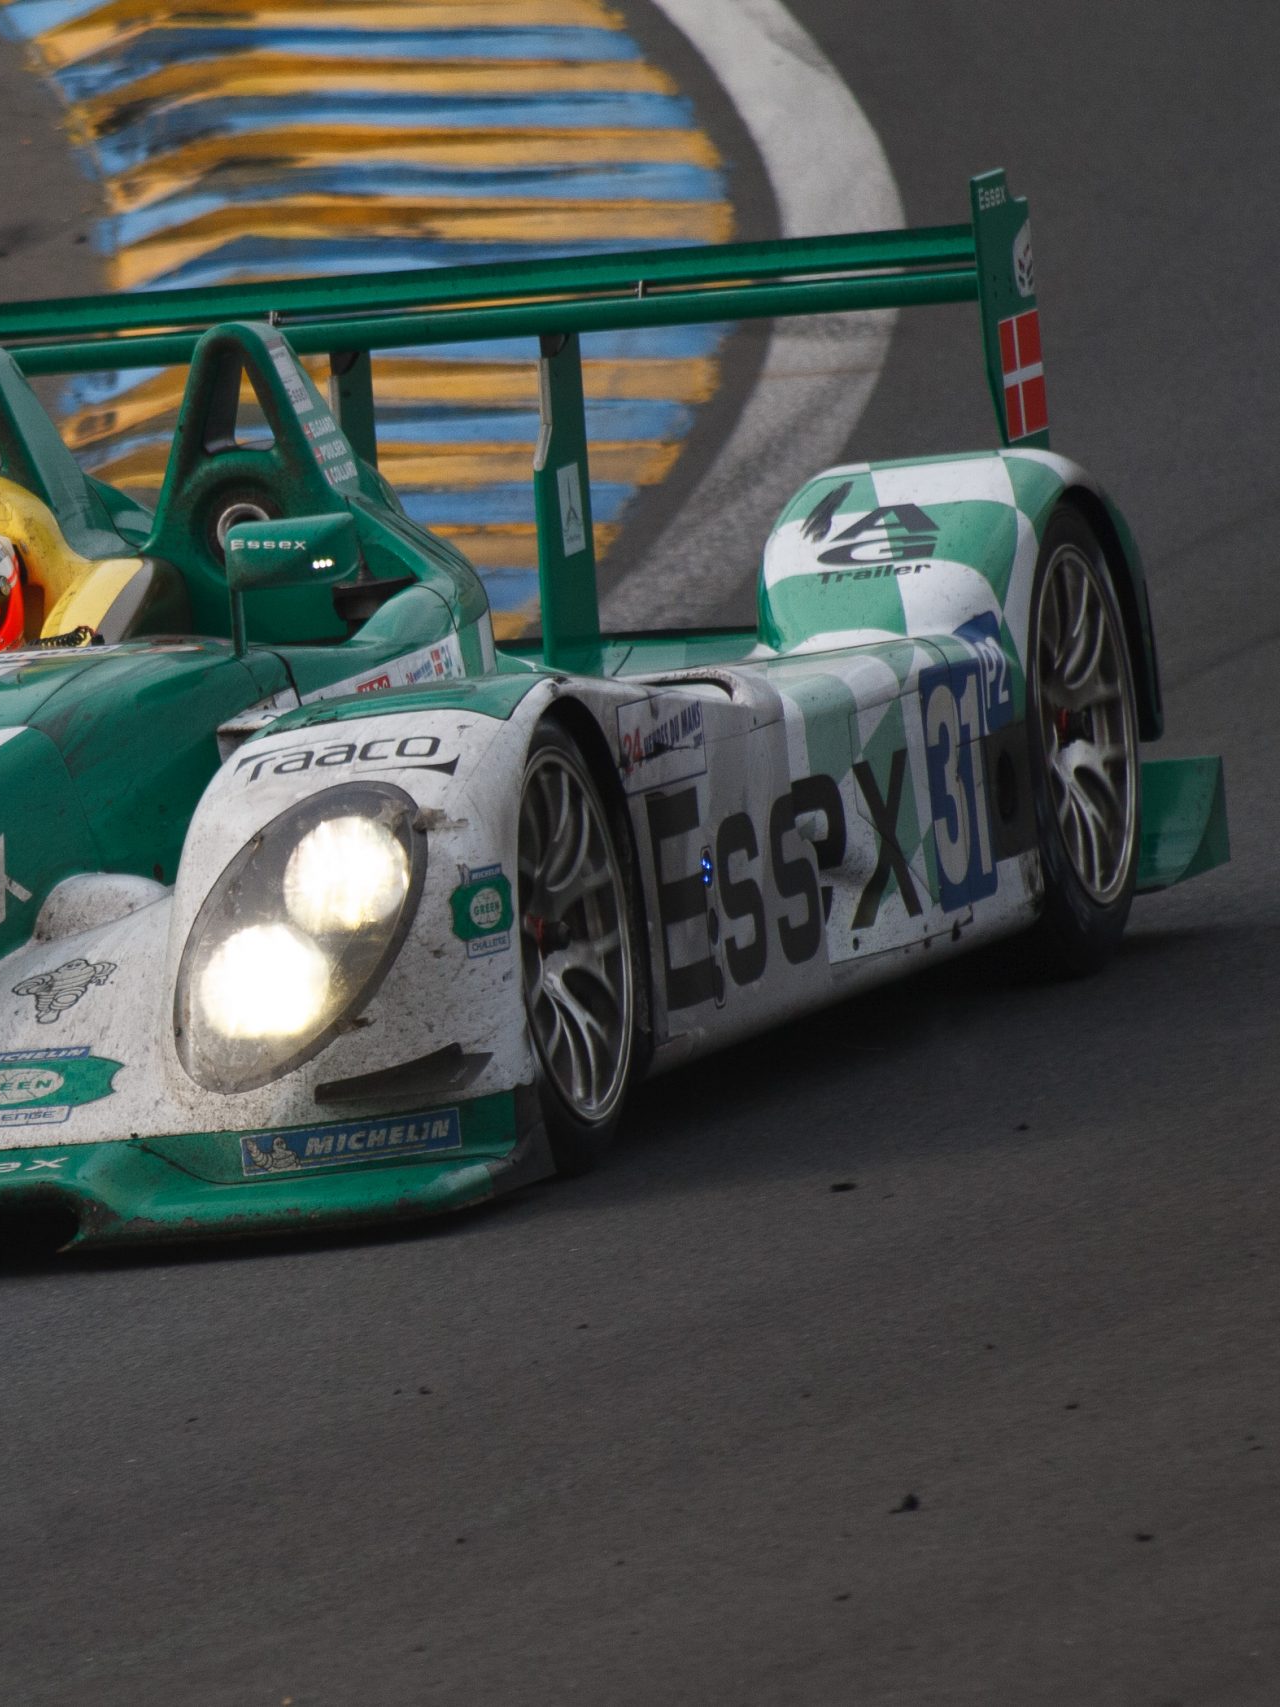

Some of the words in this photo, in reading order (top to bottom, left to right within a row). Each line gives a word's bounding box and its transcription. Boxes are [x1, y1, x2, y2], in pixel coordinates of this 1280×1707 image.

[978, 186, 1006, 210] Essex
[319, 439, 348, 460] POULSEN
[230, 539, 307, 551] Essex
[817, 563, 932, 585] Trailer
[986, 637, 1010, 709] P2
[926, 674, 994, 886] 31
[473, 902, 500, 915] GREEN
[304, 1119, 452, 1156] MICHELIN
